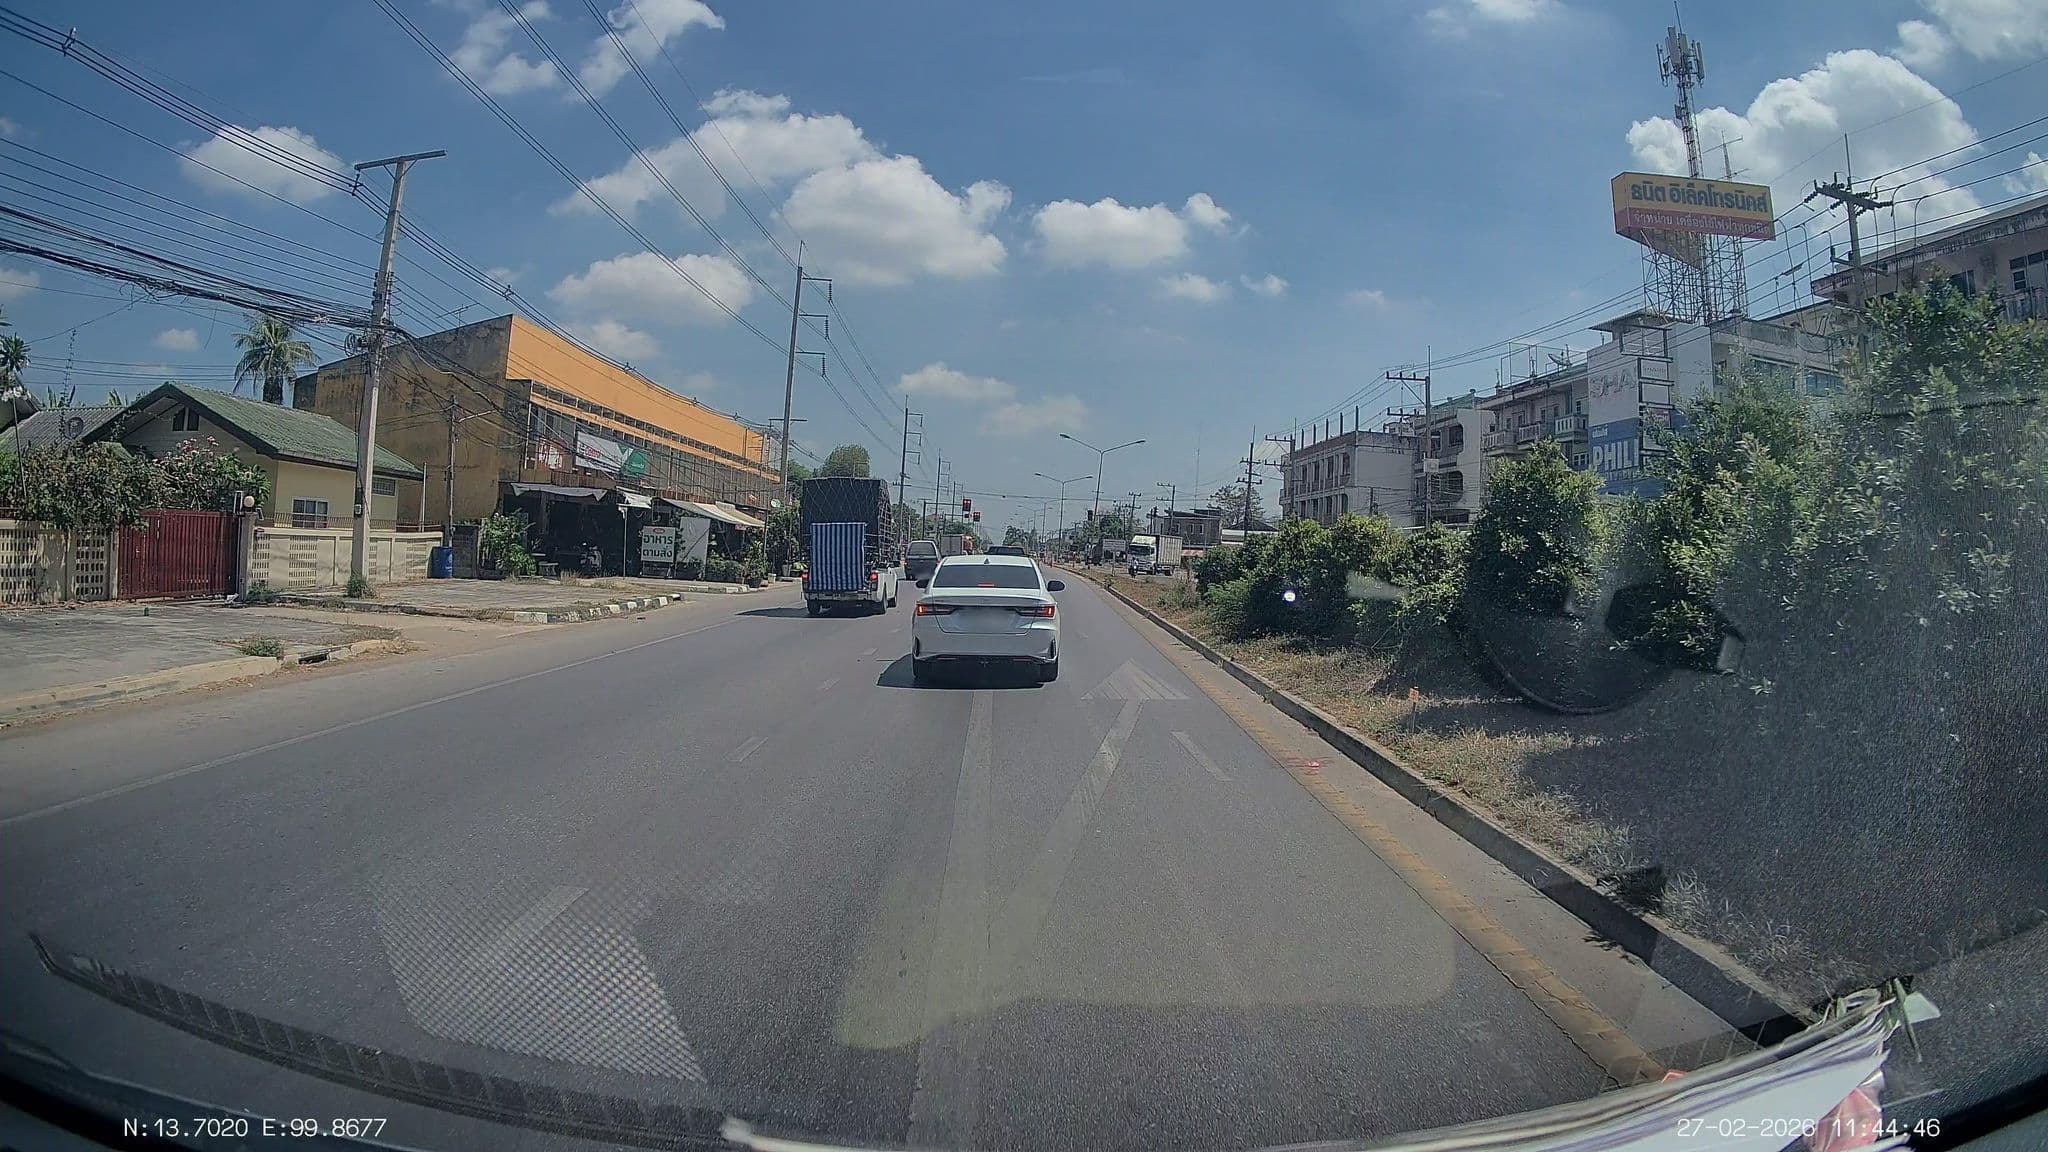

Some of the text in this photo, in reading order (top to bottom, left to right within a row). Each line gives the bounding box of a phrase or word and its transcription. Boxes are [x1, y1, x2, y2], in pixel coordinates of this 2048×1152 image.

[1631, 181, 1666, 202] ธนิต
[643, 535, 673, 545] อาหาร
[643, 545, 672, 557] ตามสั่ง
